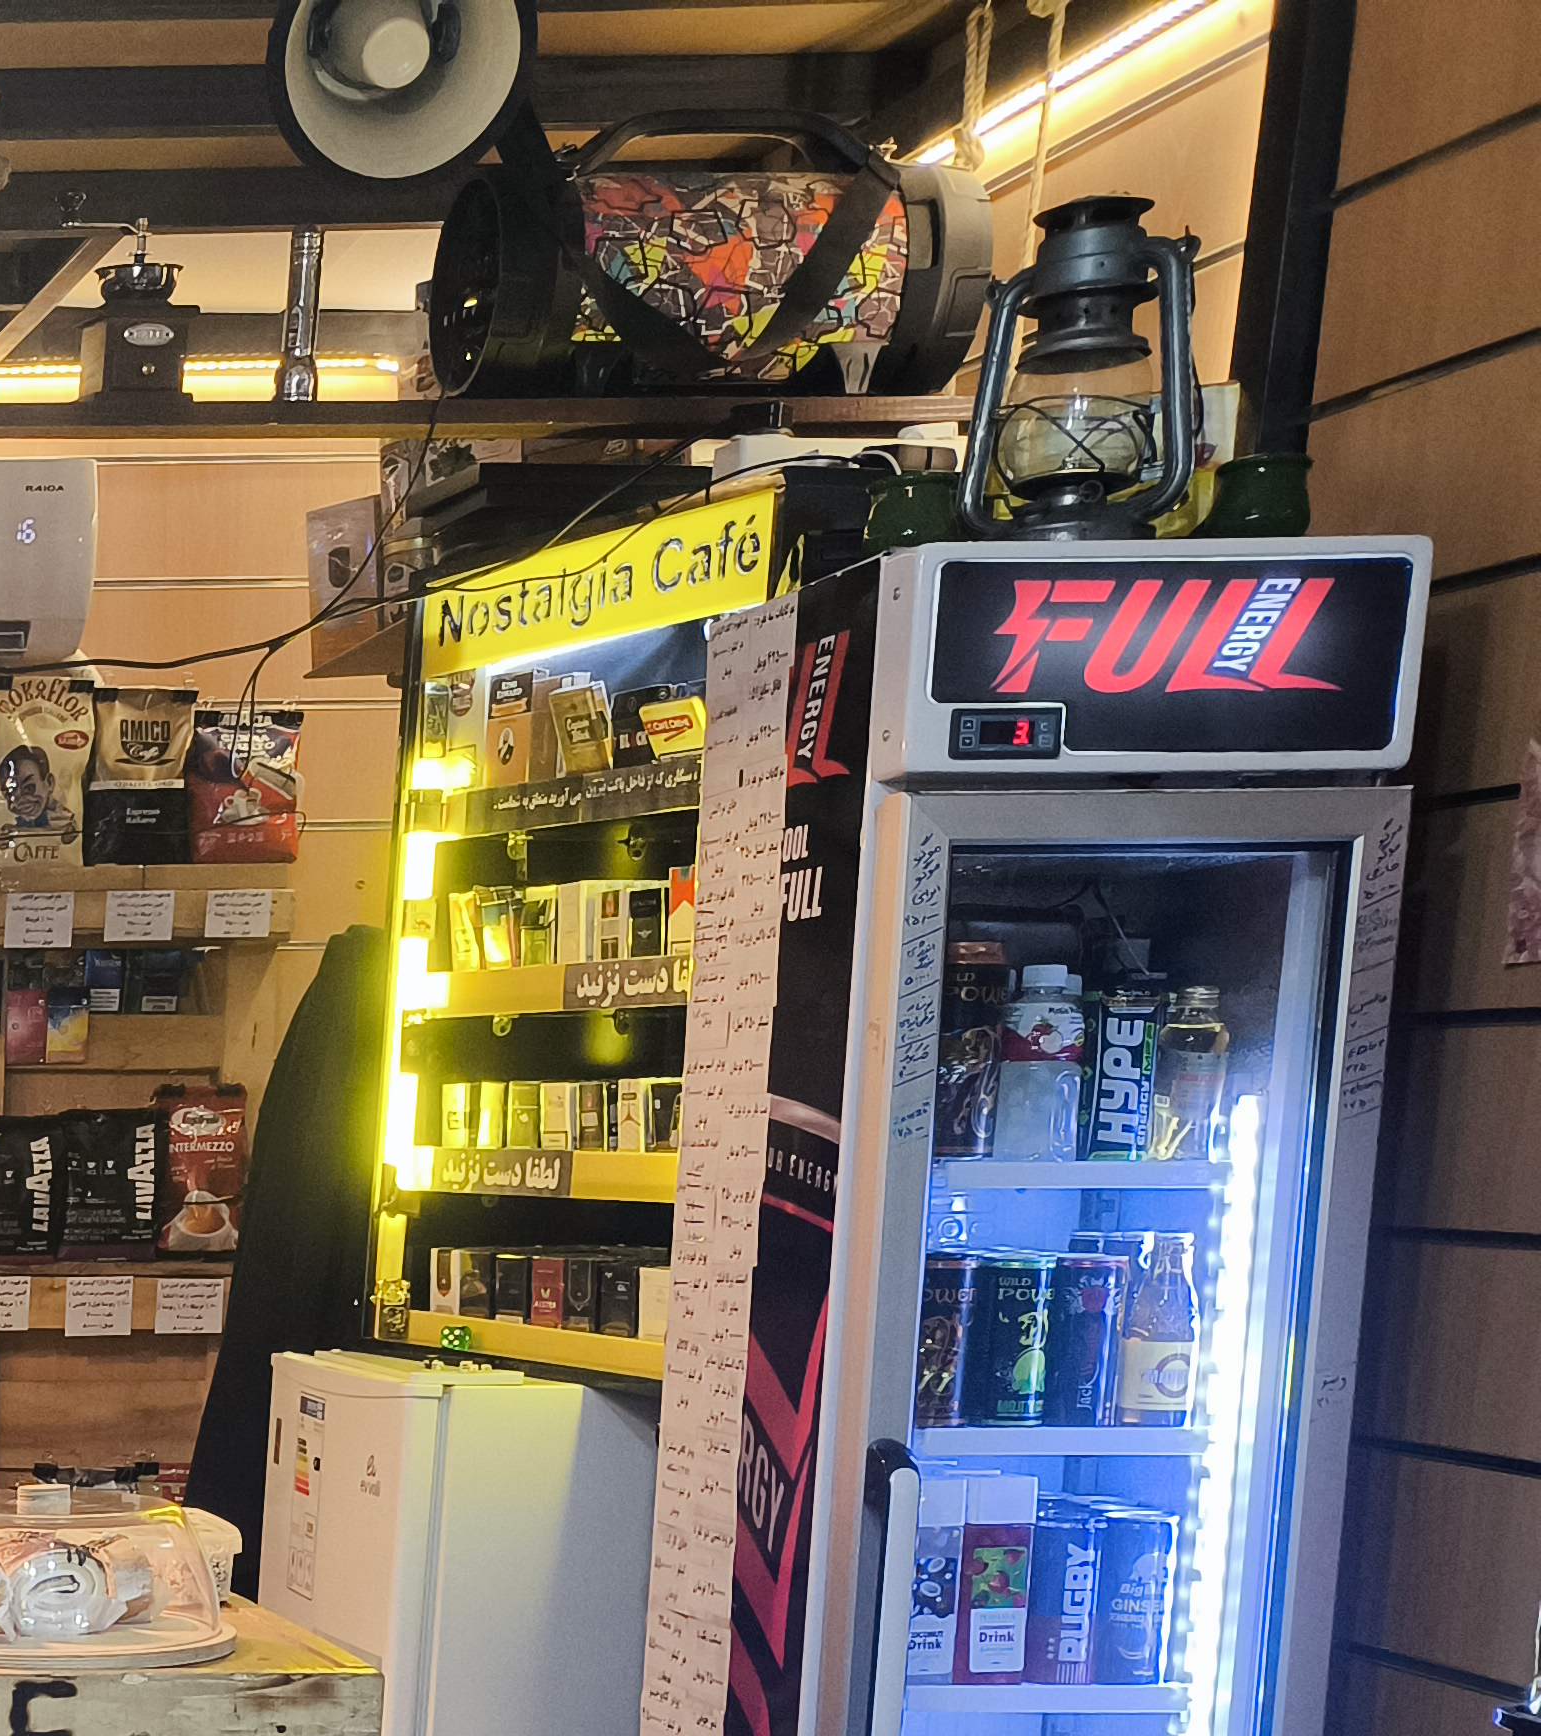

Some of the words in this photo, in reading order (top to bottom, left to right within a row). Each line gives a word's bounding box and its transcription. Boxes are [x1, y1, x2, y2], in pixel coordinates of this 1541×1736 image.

[437, 552, 635, 648] Nostalgia
[652, 515, 761, 595] Café
[1212, 577, 1302, 676] ENERGY
[989, 577, 1342, 693] FULL
[797, 634, 836, 759] ENERGY
[576, 962, 622, 1008] نزنید
[623, 965, 668, 995] دست
[1096, 1017, 1146, 1146] HYPE
[25, 1136, 53, 1232] LAVAZZA
[127, 1123, 156, 1221] LAVAZZA
[442, 1156, 480, 1190] نزنید
[481, 1161, 522, 1187] دست
[525, 1156, 560, 1190] لطفا
[1076, 1383, 1092, 1410] Jack
[979, 1629, 1015, 1643] Drink
[1058, 1542, 1096, 1663] RUGBY
